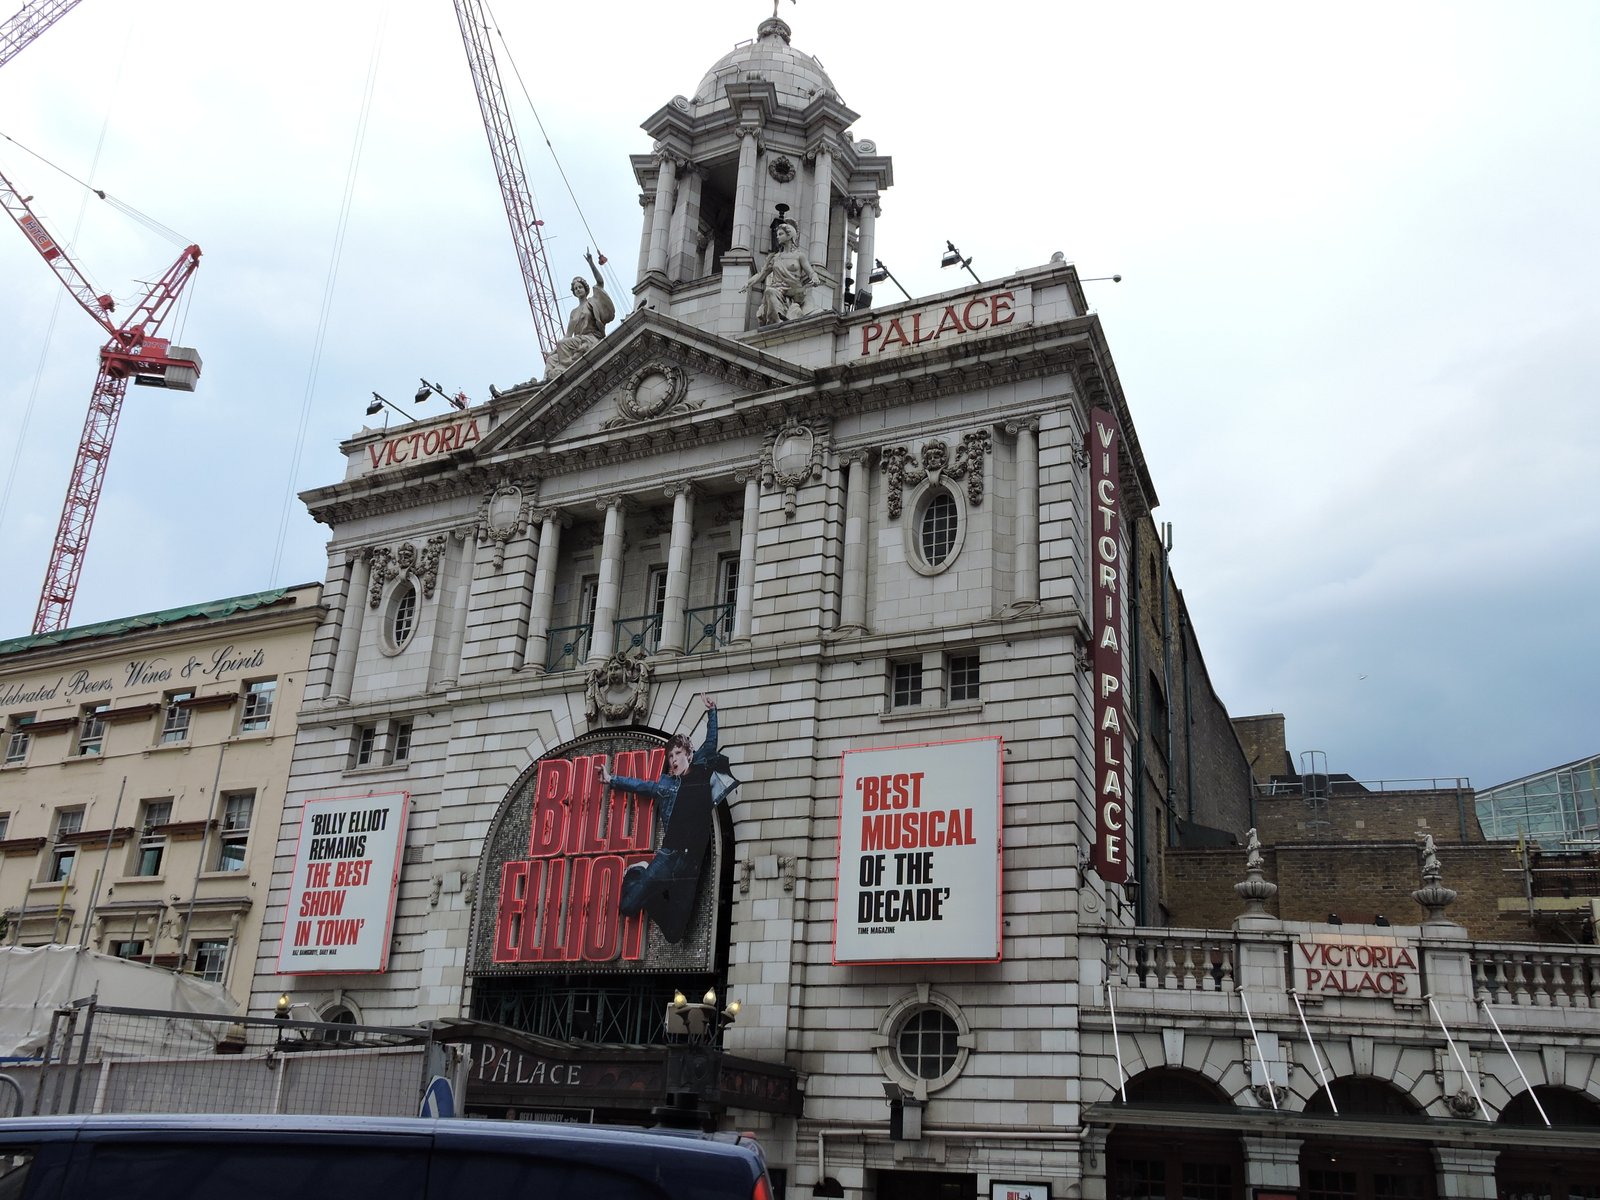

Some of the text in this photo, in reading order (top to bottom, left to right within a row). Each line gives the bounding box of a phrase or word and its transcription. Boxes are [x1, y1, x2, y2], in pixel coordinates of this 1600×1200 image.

[25, 221, 49, 245] HTC
[861, 291, 1016, 356] PALACE
[367, 419, 481, 469] VICTORIA
[1096, 421, 1123, 865] VICTORIA PALACE
[64, 669, 113, 697] Beers,
[124, 658, 172, 688] Wines
[180, 655, 202, 679] &
[202, 645, 265, 681] Spirits
[529, 747, 666, 858] BILLY
[855, 772, 925, 812] 'BEST
[311, 808, 390, 836] 'BILLY ELLIOT
[860, 808, 976, 851] MUSICAL
[309, 835, 367, 861] REMAINS
[305, 859, 373, 889] THE BEST
[859, 852, 934, 887] OF THE
[299, 889, 347, 917] SHOW
[857, 887, 950, 924] DECADE'
[294, 918, 365, 947] IN TOWN'
[857, 926, 896, 935] TIME MAGAZINE
[1298, 942, 1417, 970] VICTORIA
[1305, 968, 1408, 995] PALACE
[478, 1043, 582, 1085] PALACE
